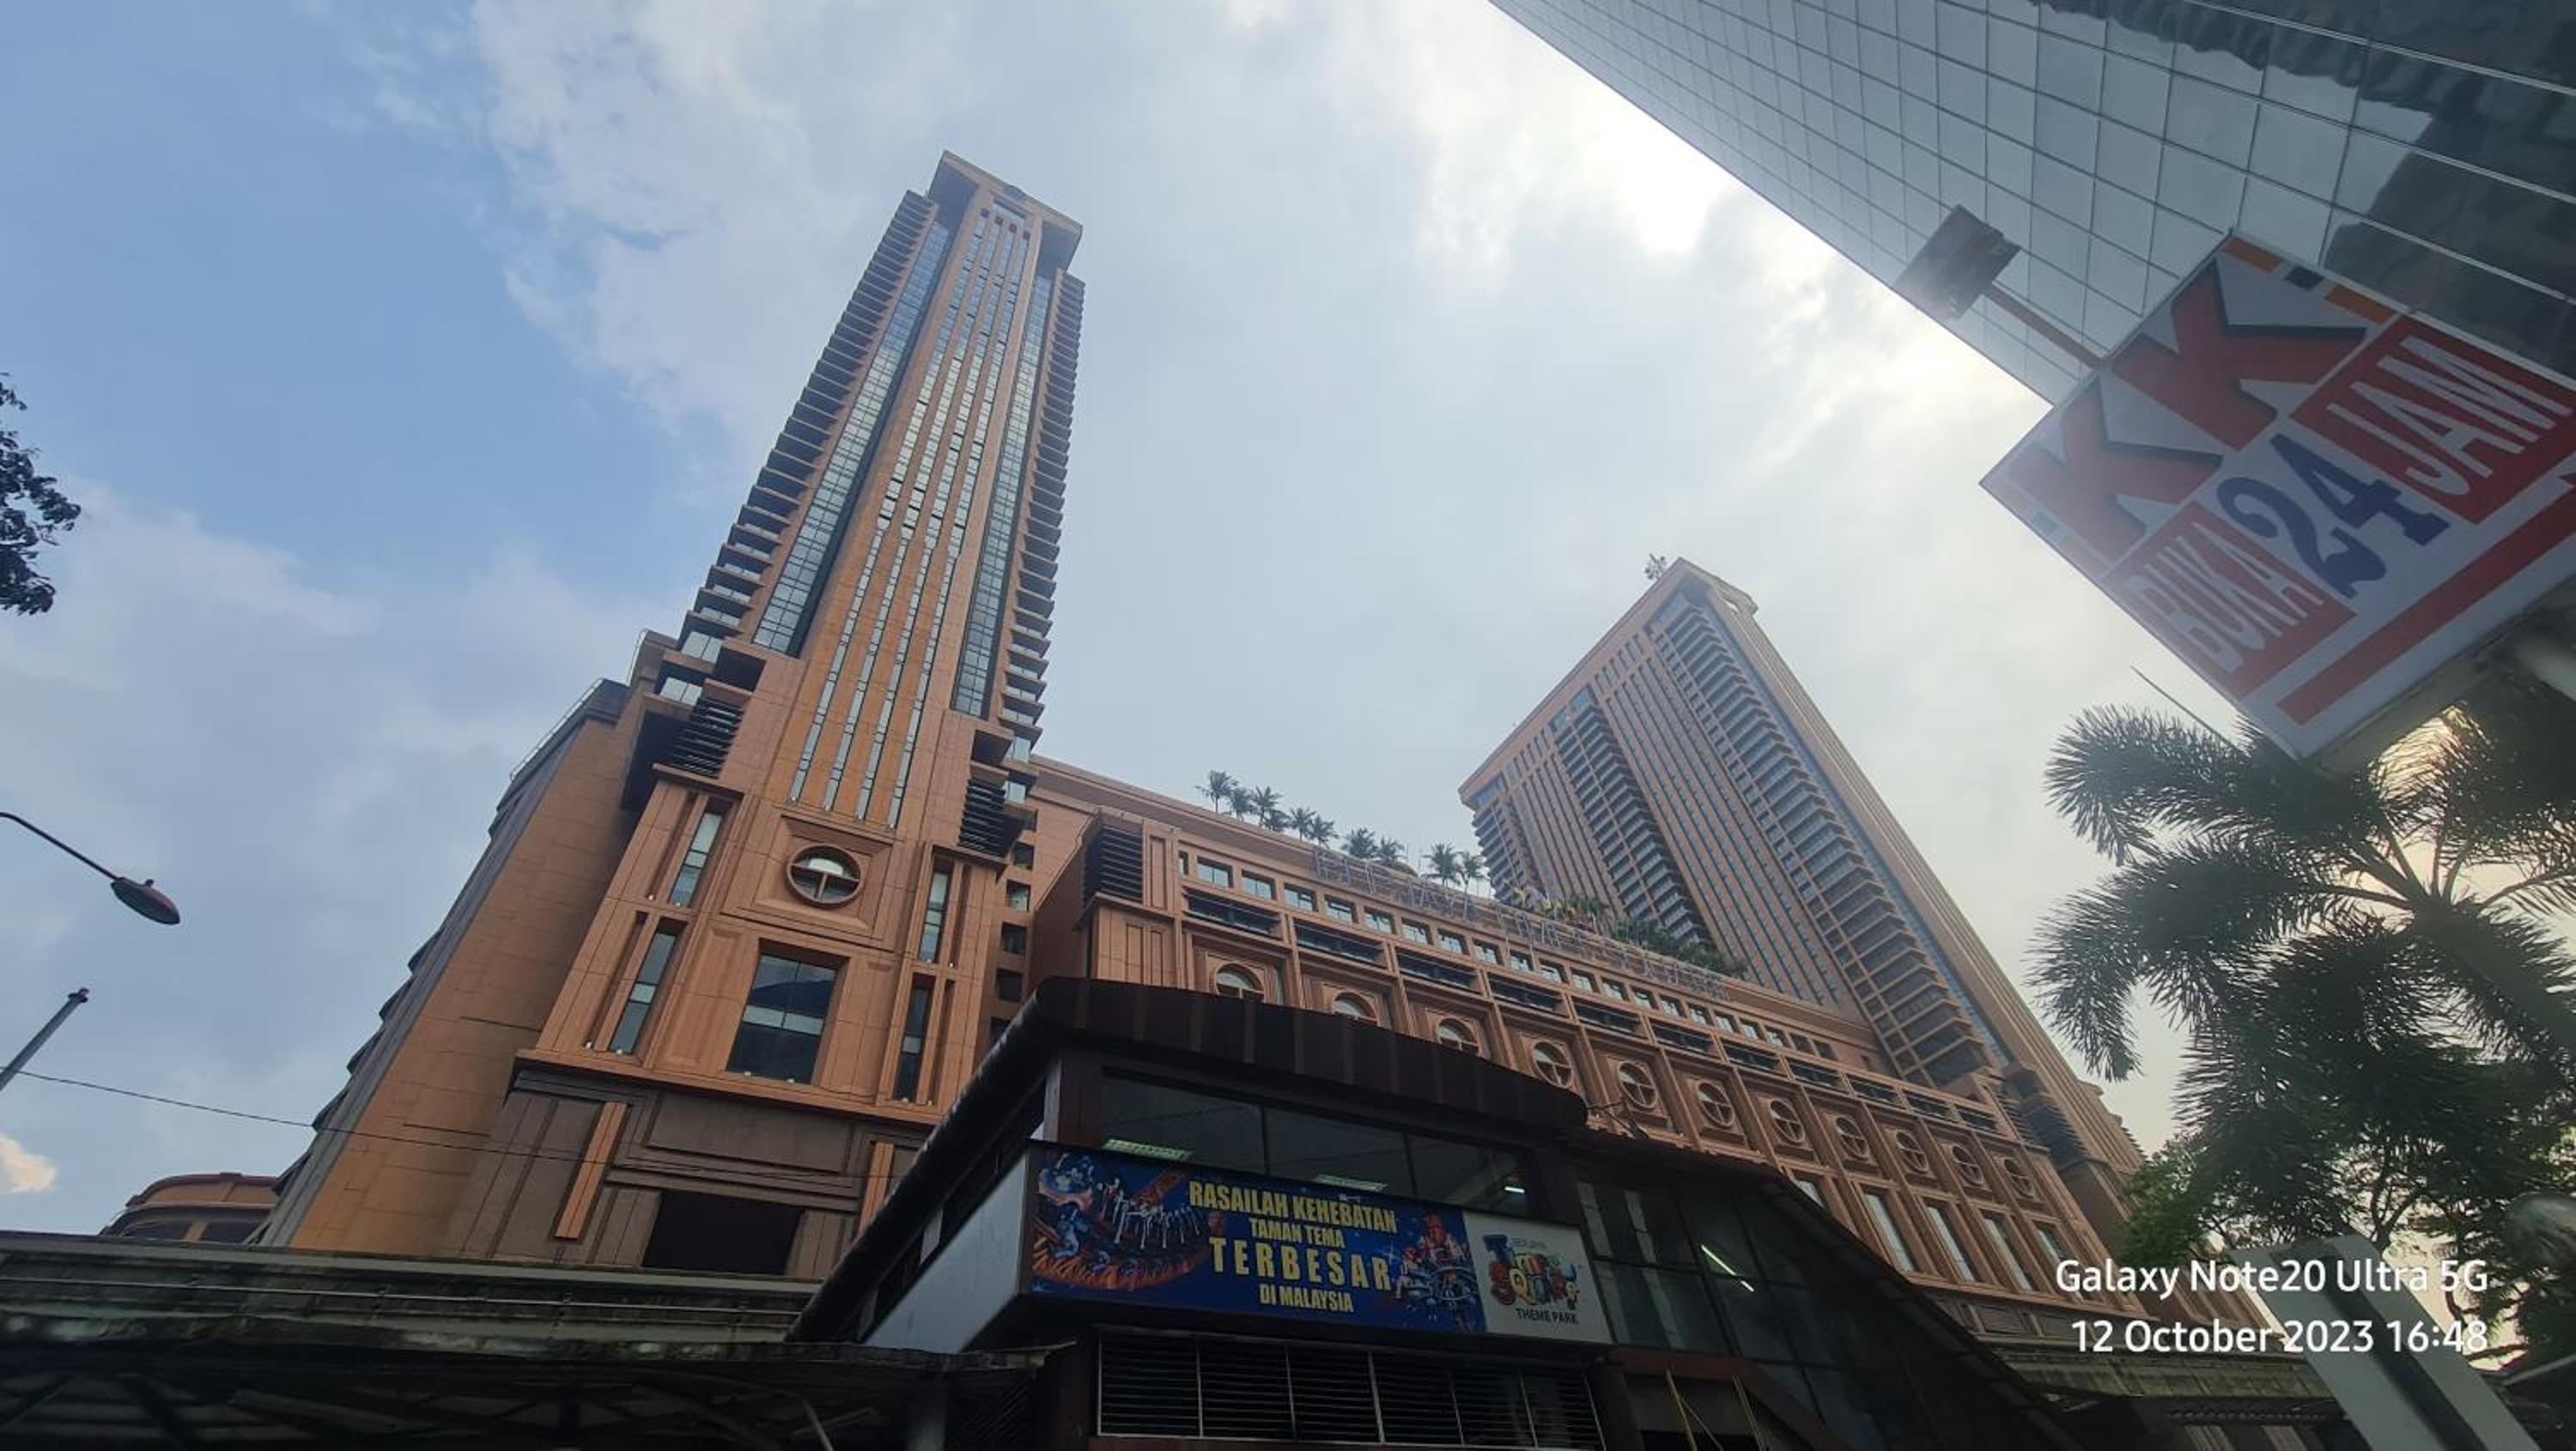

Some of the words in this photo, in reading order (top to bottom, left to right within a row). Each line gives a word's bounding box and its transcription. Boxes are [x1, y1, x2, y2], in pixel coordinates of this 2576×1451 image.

[2008, 258, 2367, 565] KK
[2325, 335, 2574, 496] JAM
[2217, 433, 2449, 599] 24
[2123, 522, 2324, 673] BUKA
[1188, 1181, 1289, 1217] RASAILAH
[1292, 1195, 1398, 1234] KEHEBATAN
[1249, 1217, 1303, 1243] TAMAN
[1306, 1224, 1346, 1248] TEMA
[1209, 1235, 1392, 1291] TERBESAR
[1259, 1284, 1277, 1305] DI
[1279, 1286, 1354, 1313] MALAYSIA
[1515, 1308, 1551, 1323] THEME
[1552, 1311, 1580, 1326] PARK
